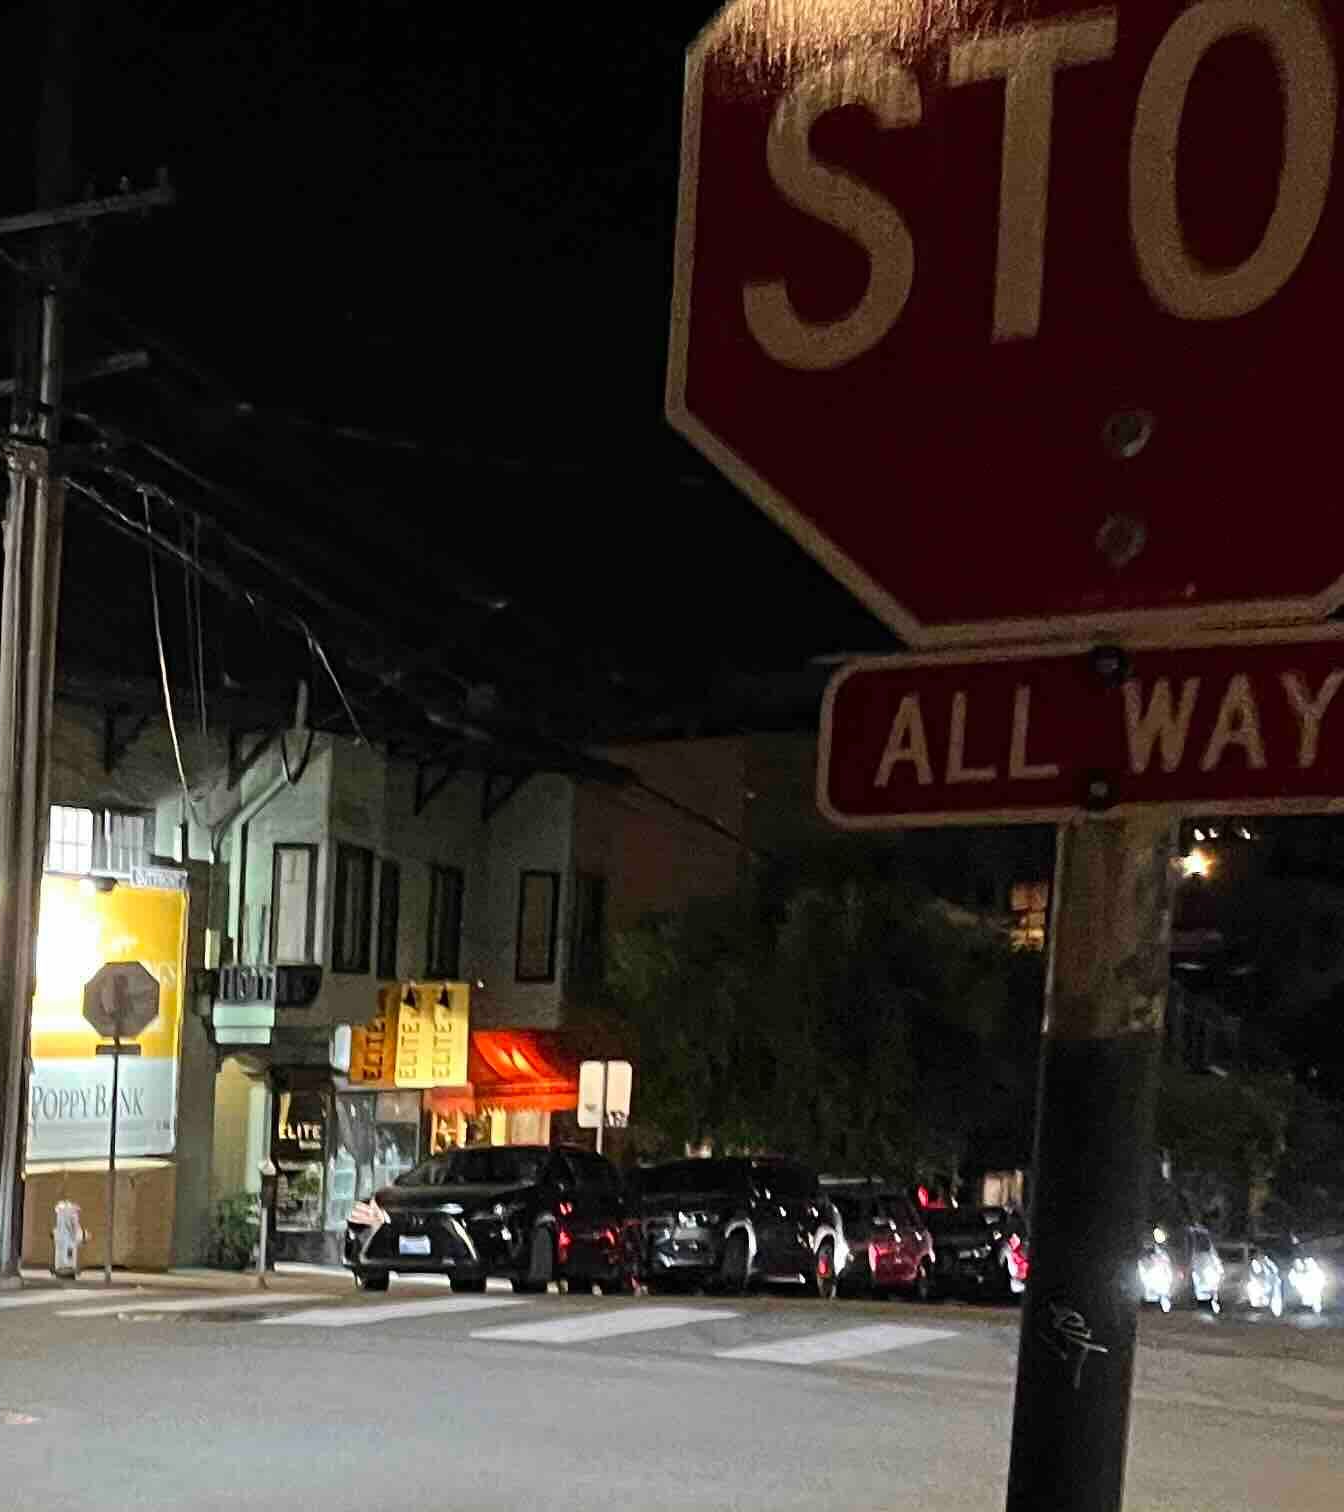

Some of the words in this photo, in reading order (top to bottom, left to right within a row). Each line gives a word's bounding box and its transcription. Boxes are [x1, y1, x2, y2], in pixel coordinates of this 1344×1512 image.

[743, 0, 1337, 371] STO
[874, 683, 1060, 788] ALL
[1121, 671, 1344, 774] WAY
[398, 1022, 420, 1079] ELITE
[431, 1022, 453, 1078] ELITE
[31, 1085, 90, 1120] POPPY
[95, 1083, 144, 1118] BNK
